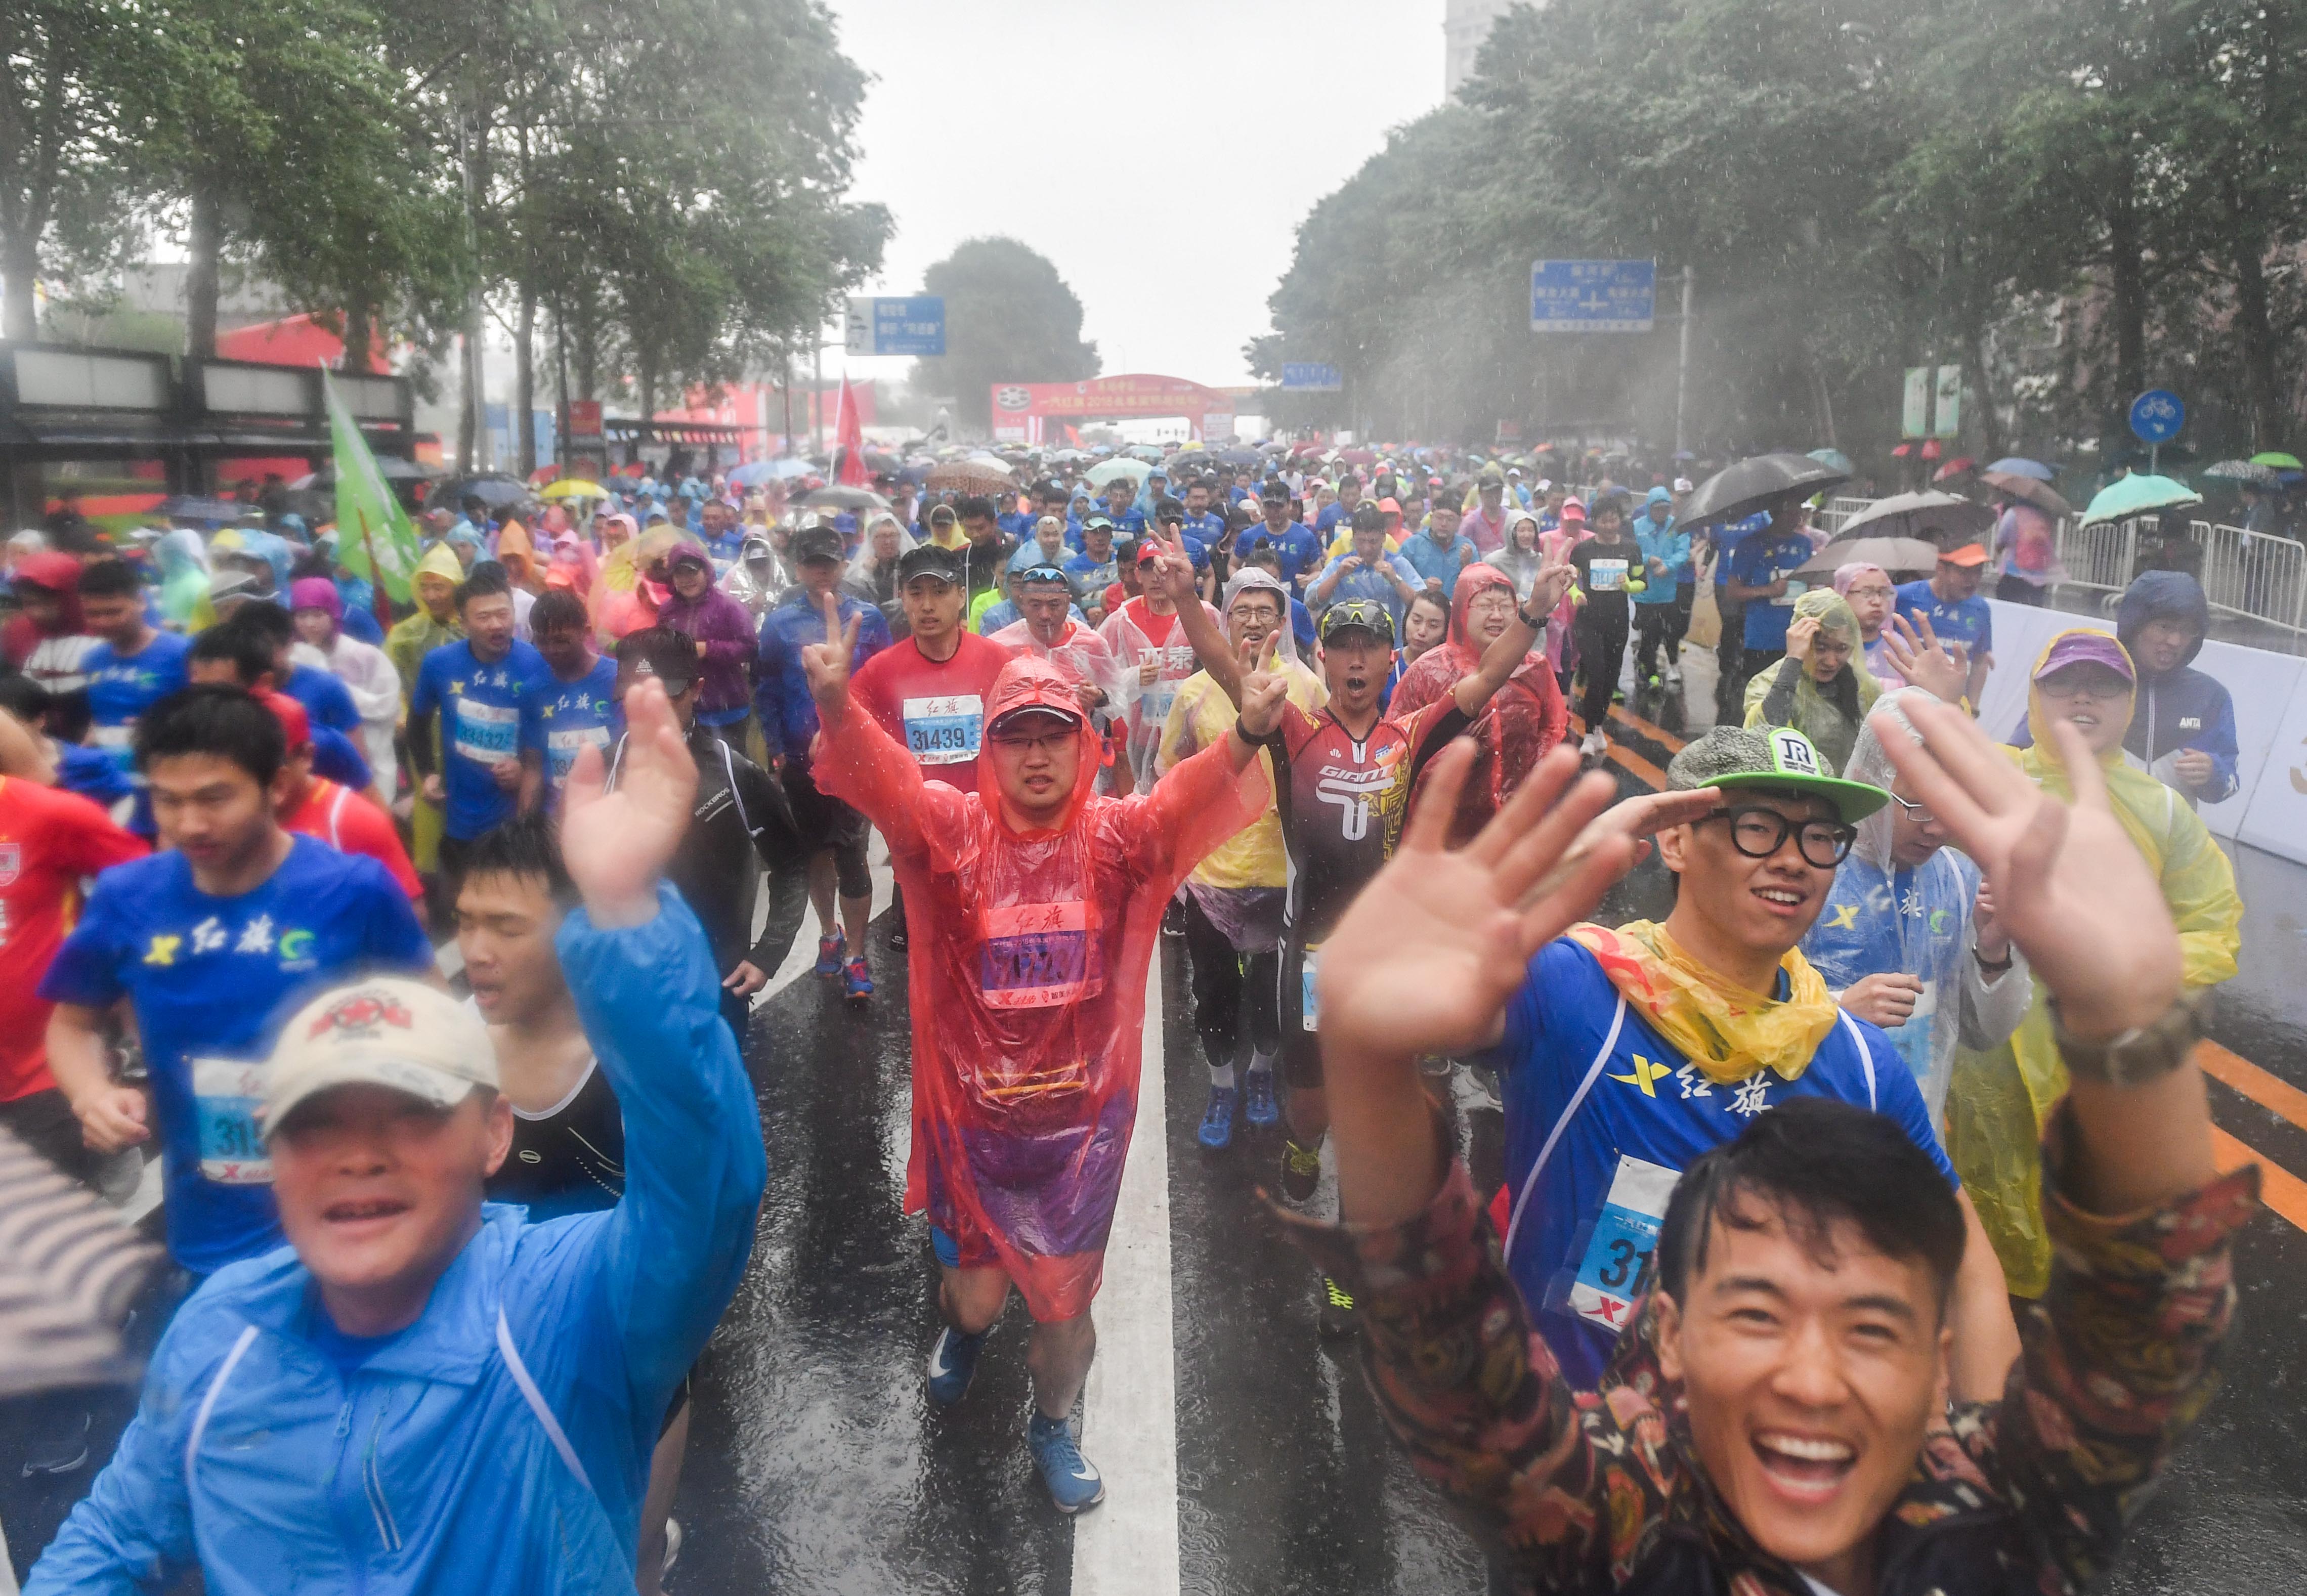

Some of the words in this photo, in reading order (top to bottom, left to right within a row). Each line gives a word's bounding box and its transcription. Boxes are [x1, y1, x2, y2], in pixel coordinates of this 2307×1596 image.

[927, 698, 959, 717] 红旗
[2180, 717, 2201, 728] ANTA
[913, 727, 965, 750] 31439
[1318, 763, 1394, 782] GIANT
[695, 787, 730, 817] ROCKBROS
[1015, 905, 1064, 937] 红旗
[1676, 1061, 1773, 1117] 红旗
